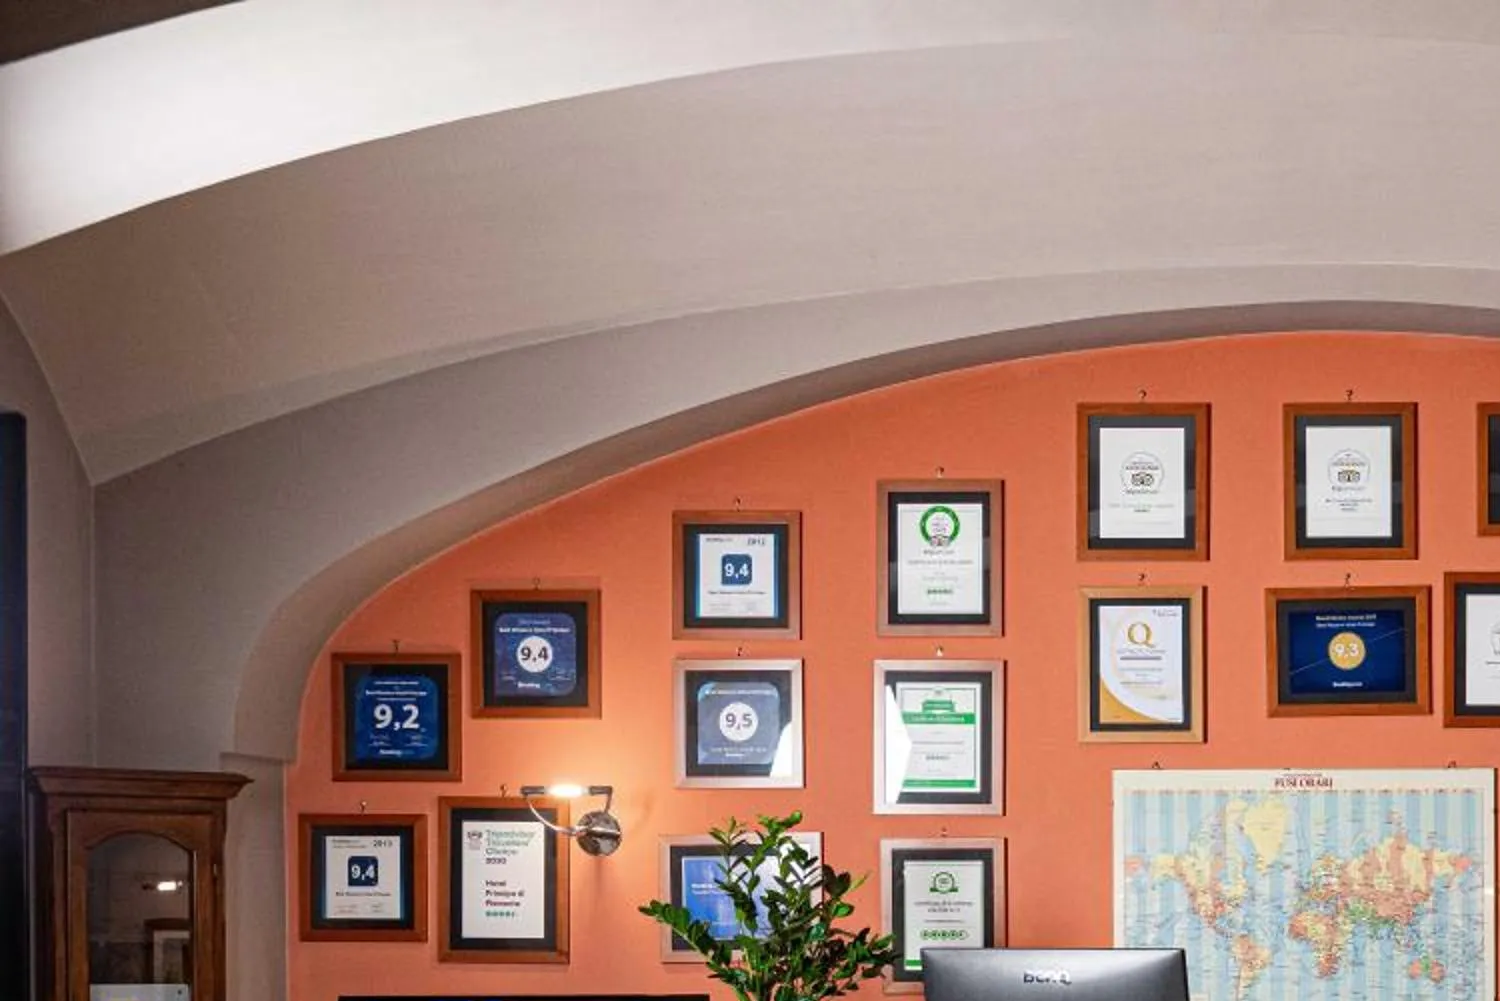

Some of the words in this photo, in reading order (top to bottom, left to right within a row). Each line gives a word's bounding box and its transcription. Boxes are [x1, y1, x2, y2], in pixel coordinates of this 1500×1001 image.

[724, 563, 749, 579] 9,4
[1128, 621, 1156, 649] Q
[520, 646, 549, 663] 9,4
[373, 703, 420, 731] 9,2
[725, 713, 753, 730] 9,5
[351, 864, 375, 881] 9,4
